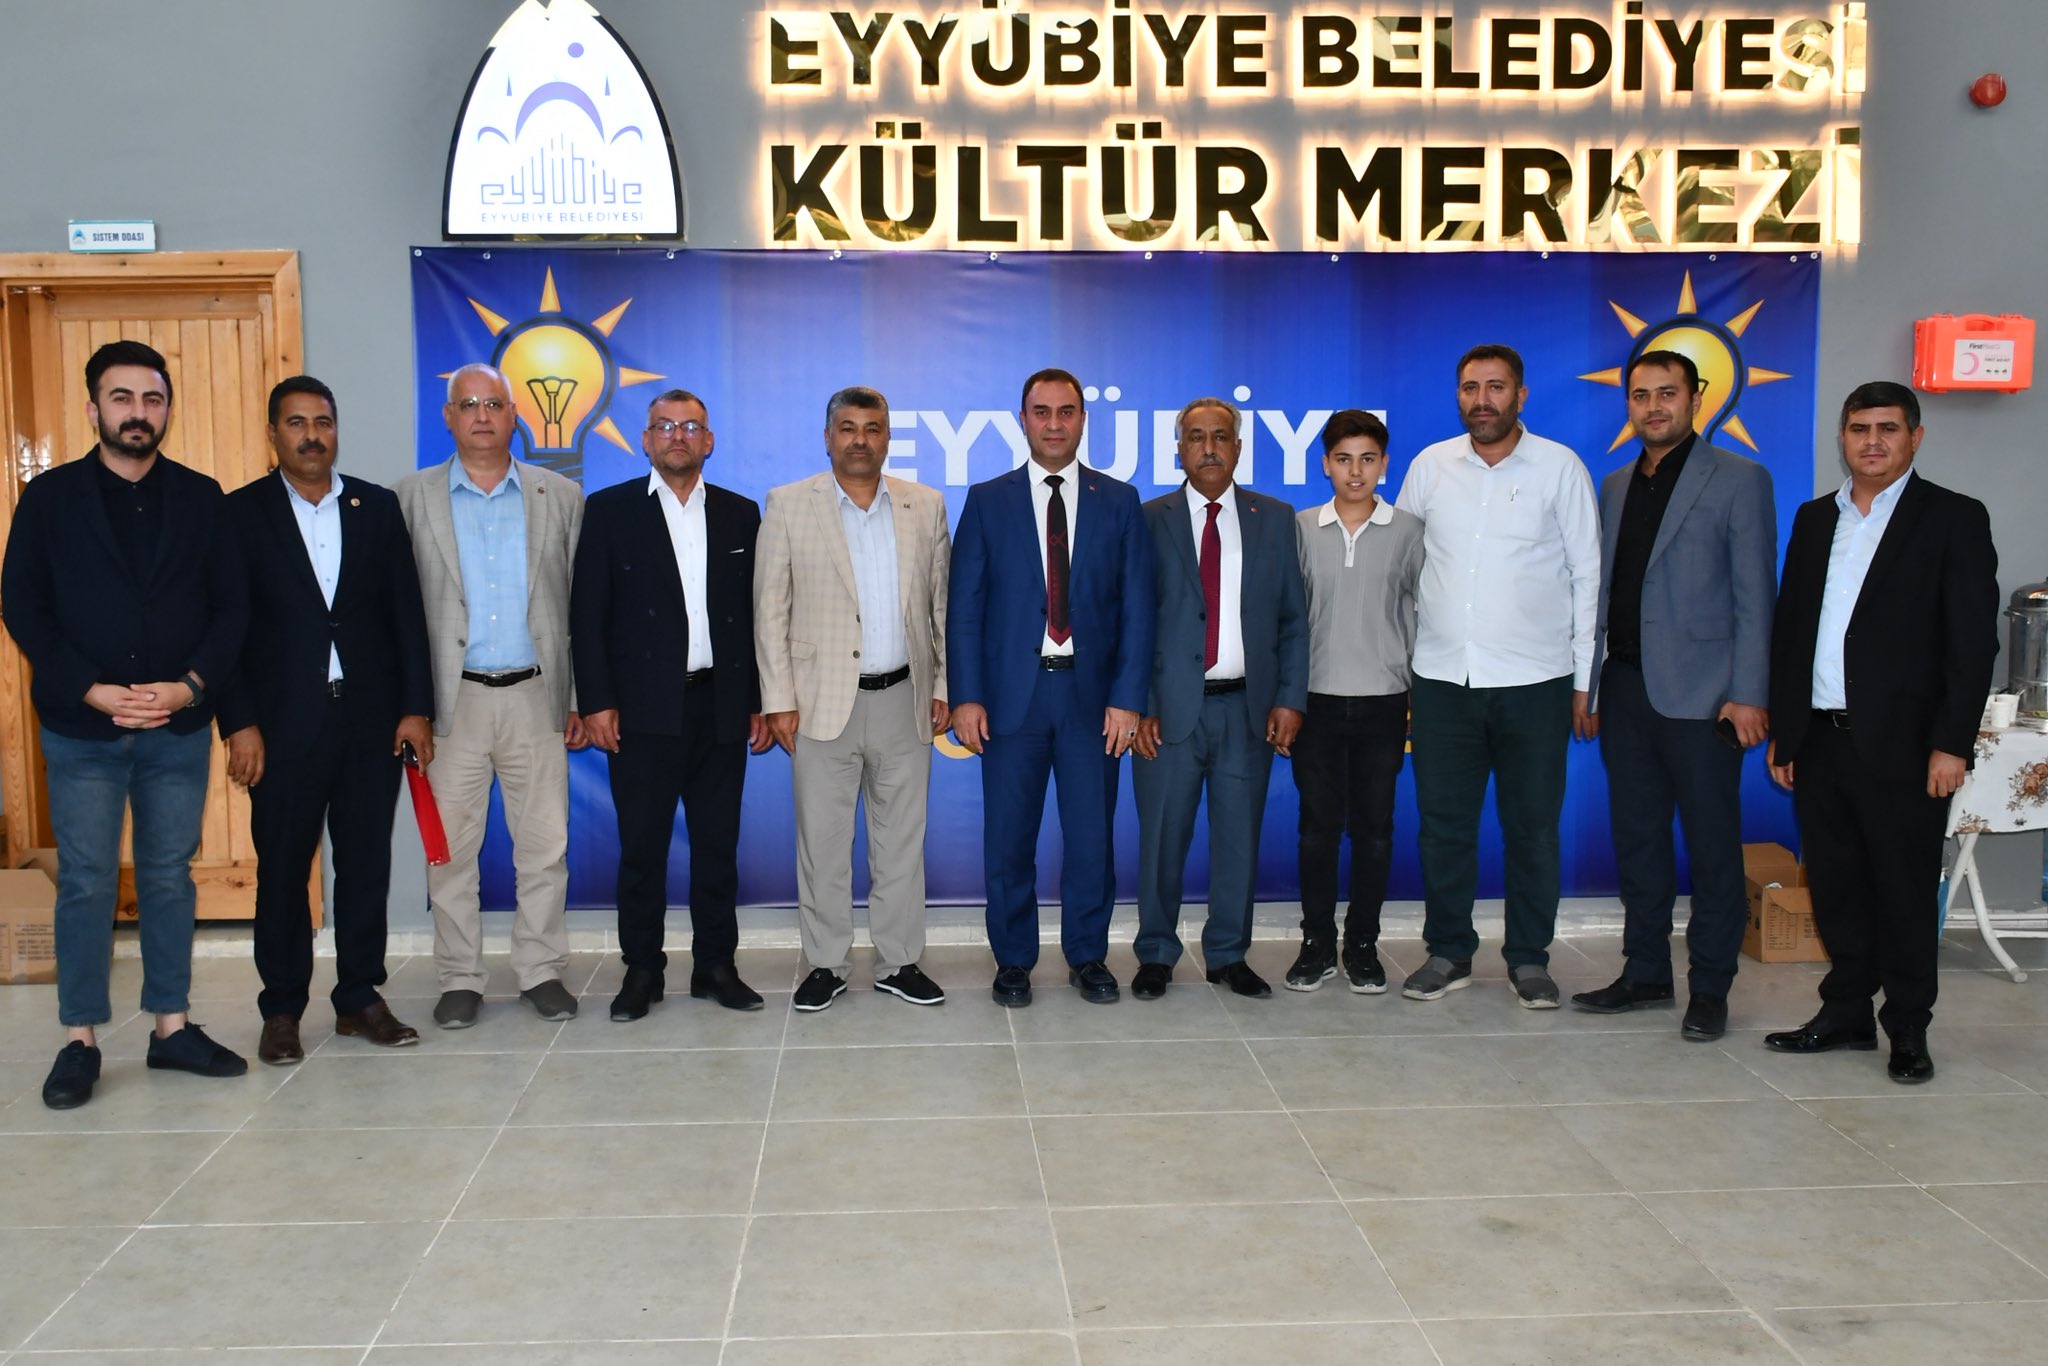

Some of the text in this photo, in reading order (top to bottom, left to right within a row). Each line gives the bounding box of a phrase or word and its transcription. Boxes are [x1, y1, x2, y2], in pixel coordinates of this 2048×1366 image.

[771, 0, 1867, 93] EYYÜBİYE BELEDİYESİ
[771, 121, 1861, 244] KÜLTÜR MERKEZİ
